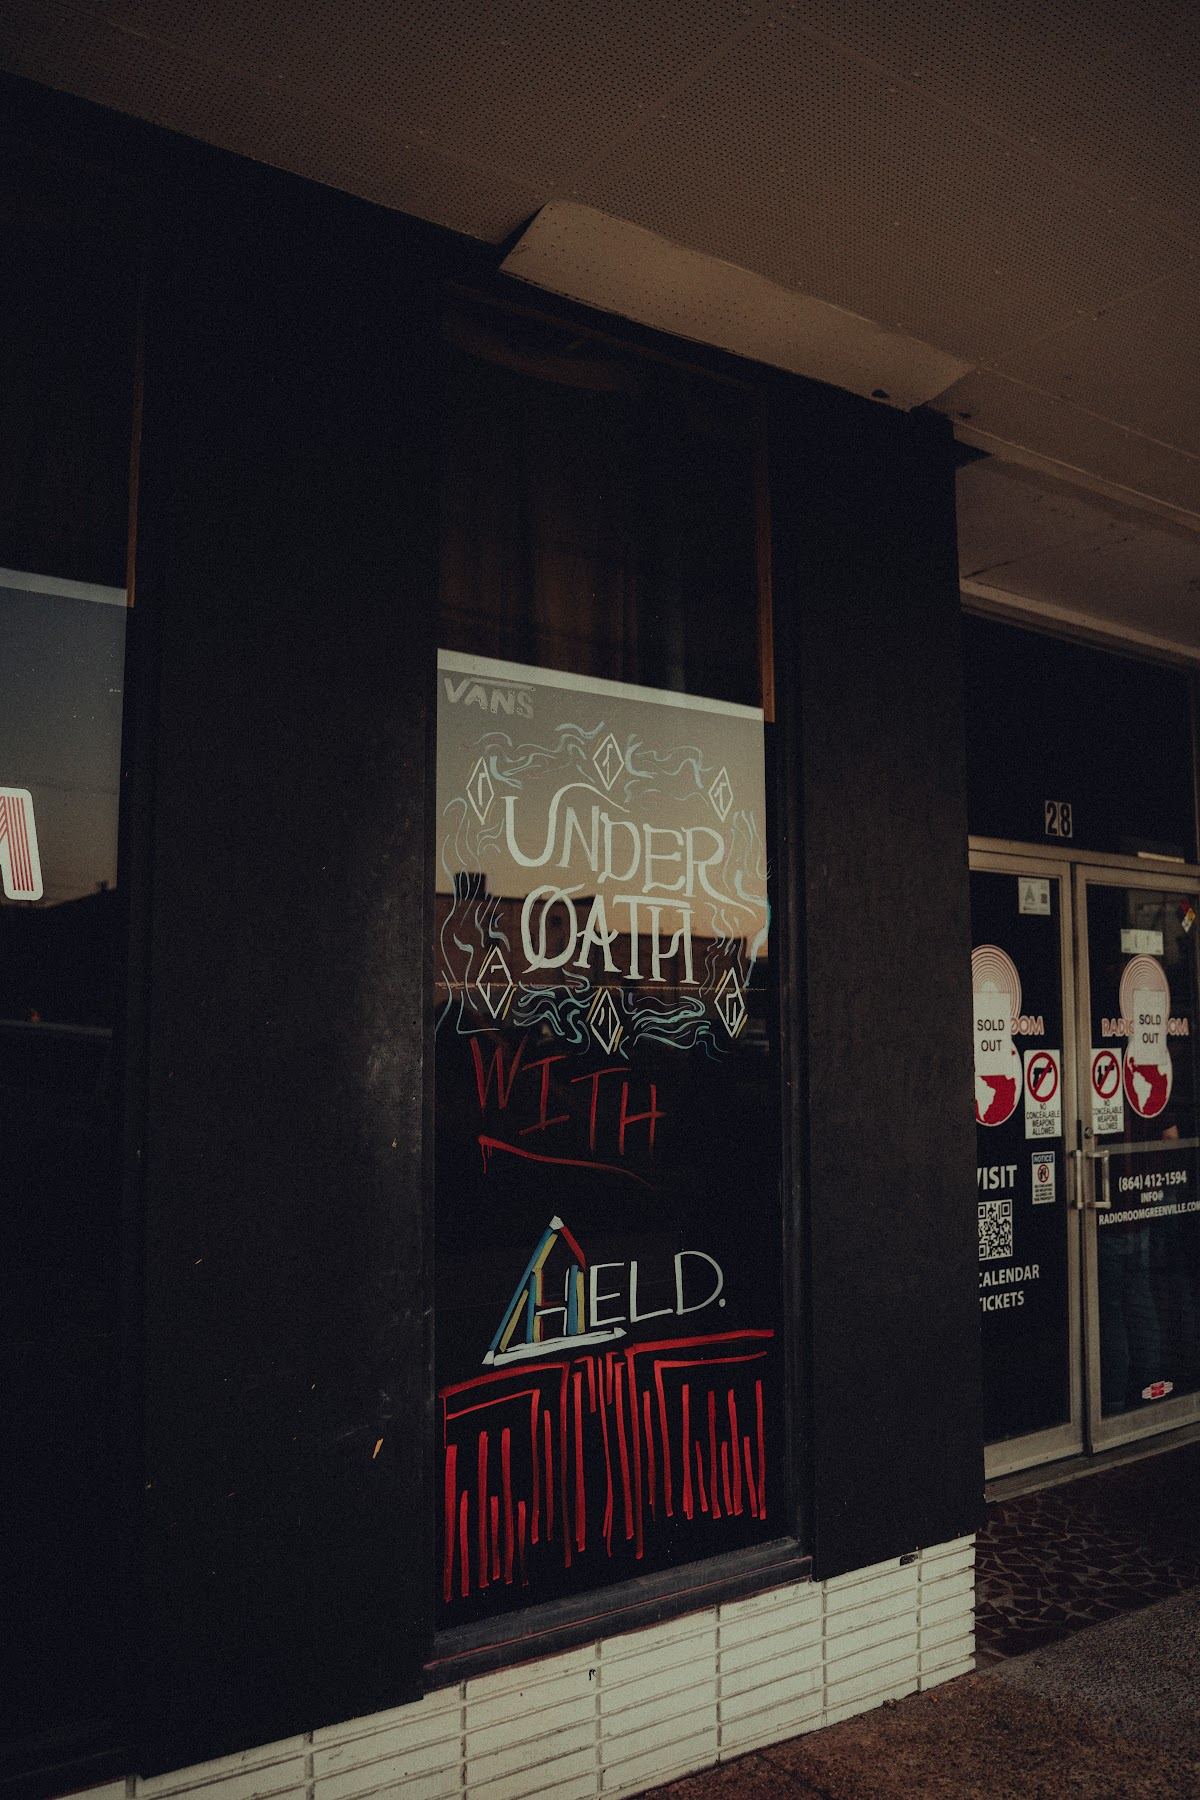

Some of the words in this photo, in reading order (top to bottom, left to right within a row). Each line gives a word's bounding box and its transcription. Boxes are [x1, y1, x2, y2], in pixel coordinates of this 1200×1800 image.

[444, 677, 535, 719] VANS
[1046, 802, 1071, 836] 28
[501, 782, 756, 918] UNDER
[520, 883, 699, 984] OATH
[977, 1019, 1005, 1031] SOLD
[1011, 1015, 1045, 1036] OOM
[1139, 1014, 1161, 1025] SOLD
[981, 1040, 1002, 1051] OUT
[1142, 1033, 1159, 1044] OUT
[469, 1034, 667, 1156] WITH
[1026, 1111, 1060, 1119] CONCEALABLE
[1032, 1119, 1055, 1127] WEAPONS
[1032, 1126, 1055, 1135] ALLOWED
[1033, 1155, 1053, 1163] NOTICE
[1119, 1174, 1143, 1192] (864)
[1144, 1170, 1187, 1188] 412-1594
[979, 1264, 1040, 1288] ALENDAR
